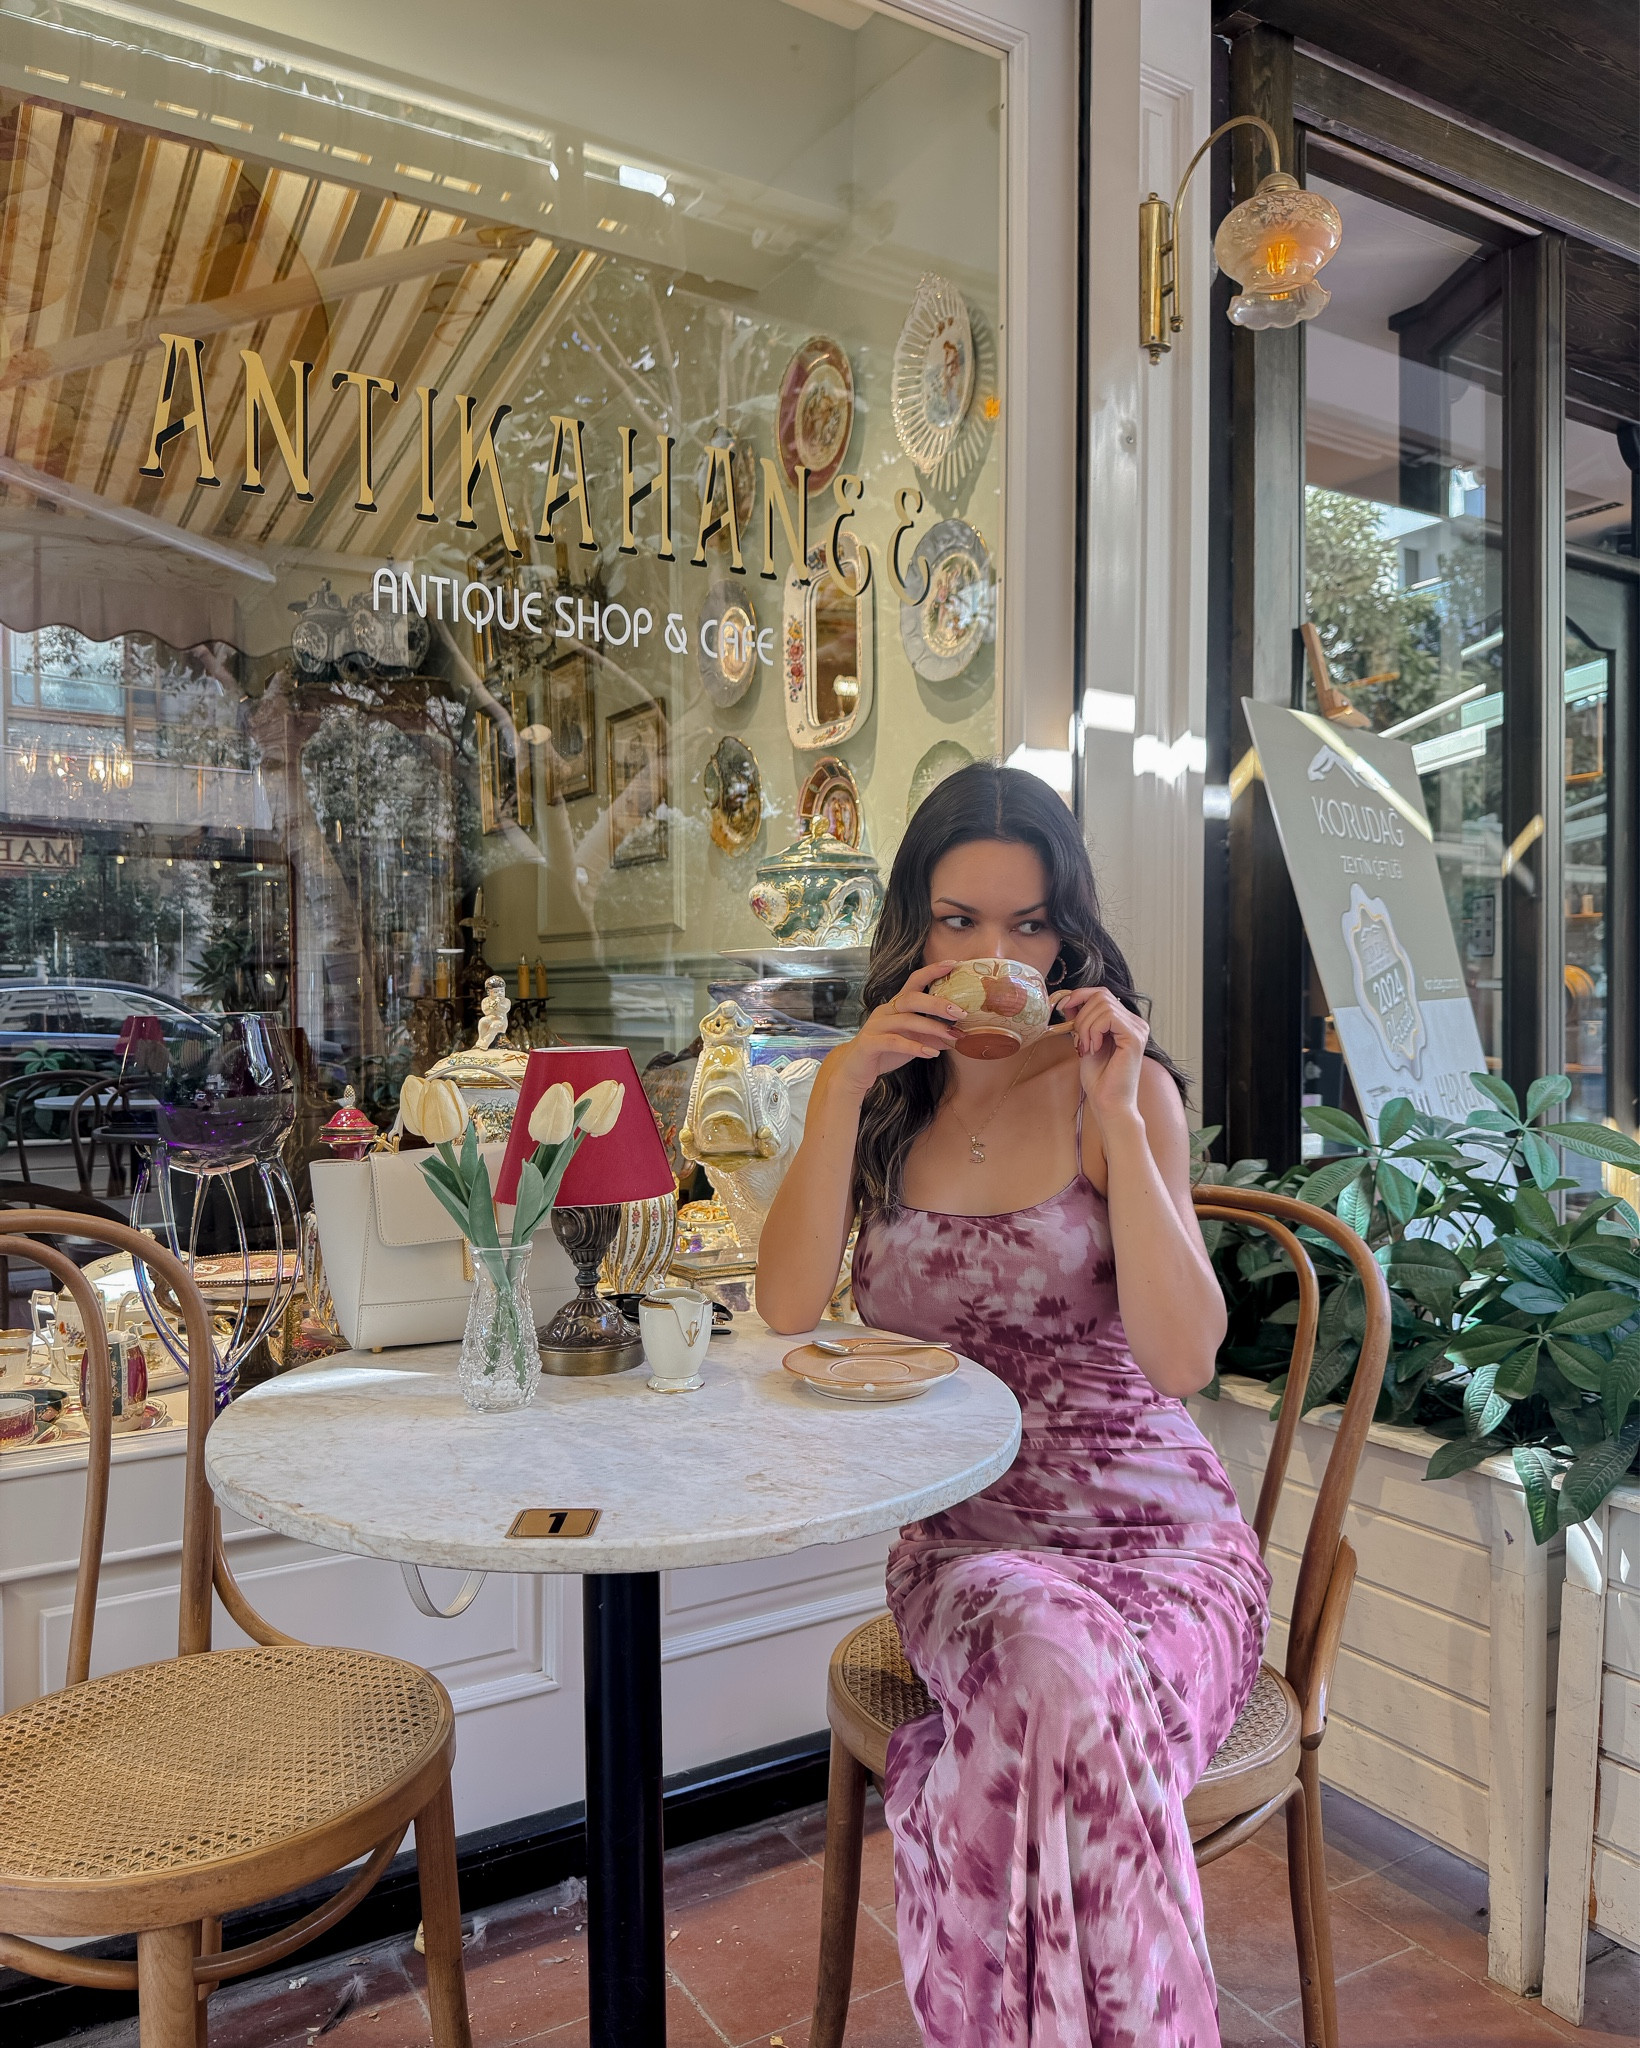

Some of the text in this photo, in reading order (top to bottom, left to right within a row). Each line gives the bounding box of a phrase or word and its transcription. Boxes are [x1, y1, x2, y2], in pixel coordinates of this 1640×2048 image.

[372, 566, 775, 667] ANTIQUE SHOP & CAFE
[1311, 796, 1405, 847] KORUDAĞ
[1373, 968, 1406, 1015] 2024
[547, 1511, 569, 1534] 1
